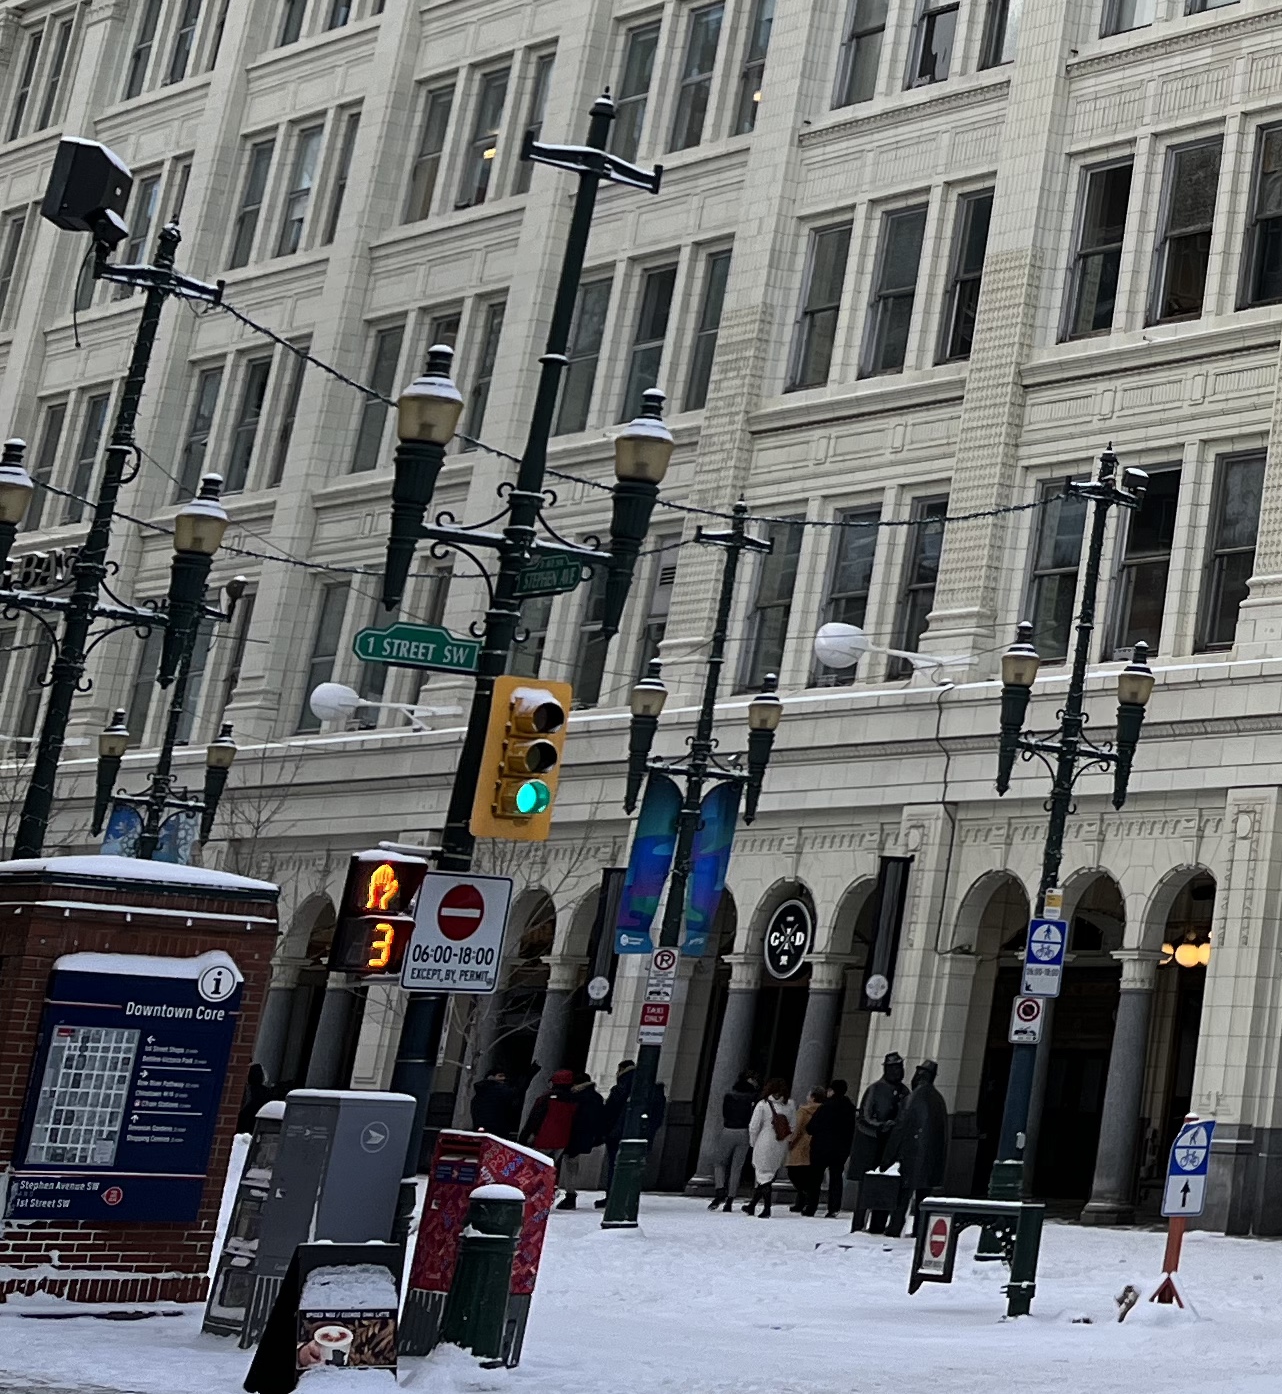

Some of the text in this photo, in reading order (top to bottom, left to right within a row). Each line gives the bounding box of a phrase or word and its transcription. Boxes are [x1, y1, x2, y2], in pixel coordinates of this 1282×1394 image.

[366, 636, 470, 665] 1 STREET SW
[368, 923, 395, 967] 3
[412, 944, 495, 965] 06:00-18:00
[411, 967, 489, 982] EXCEPT BY PERMIT
[125, 1002, 225, 1021] Downtown Core
[646, 1006, 664, 1014] TAXI
[644, 1015, 664, 1023] ONLY
[20, 1180, 101, 1191] Stephen Avenue SW
[16, 1198, 71, 1208] 1st Street SW
